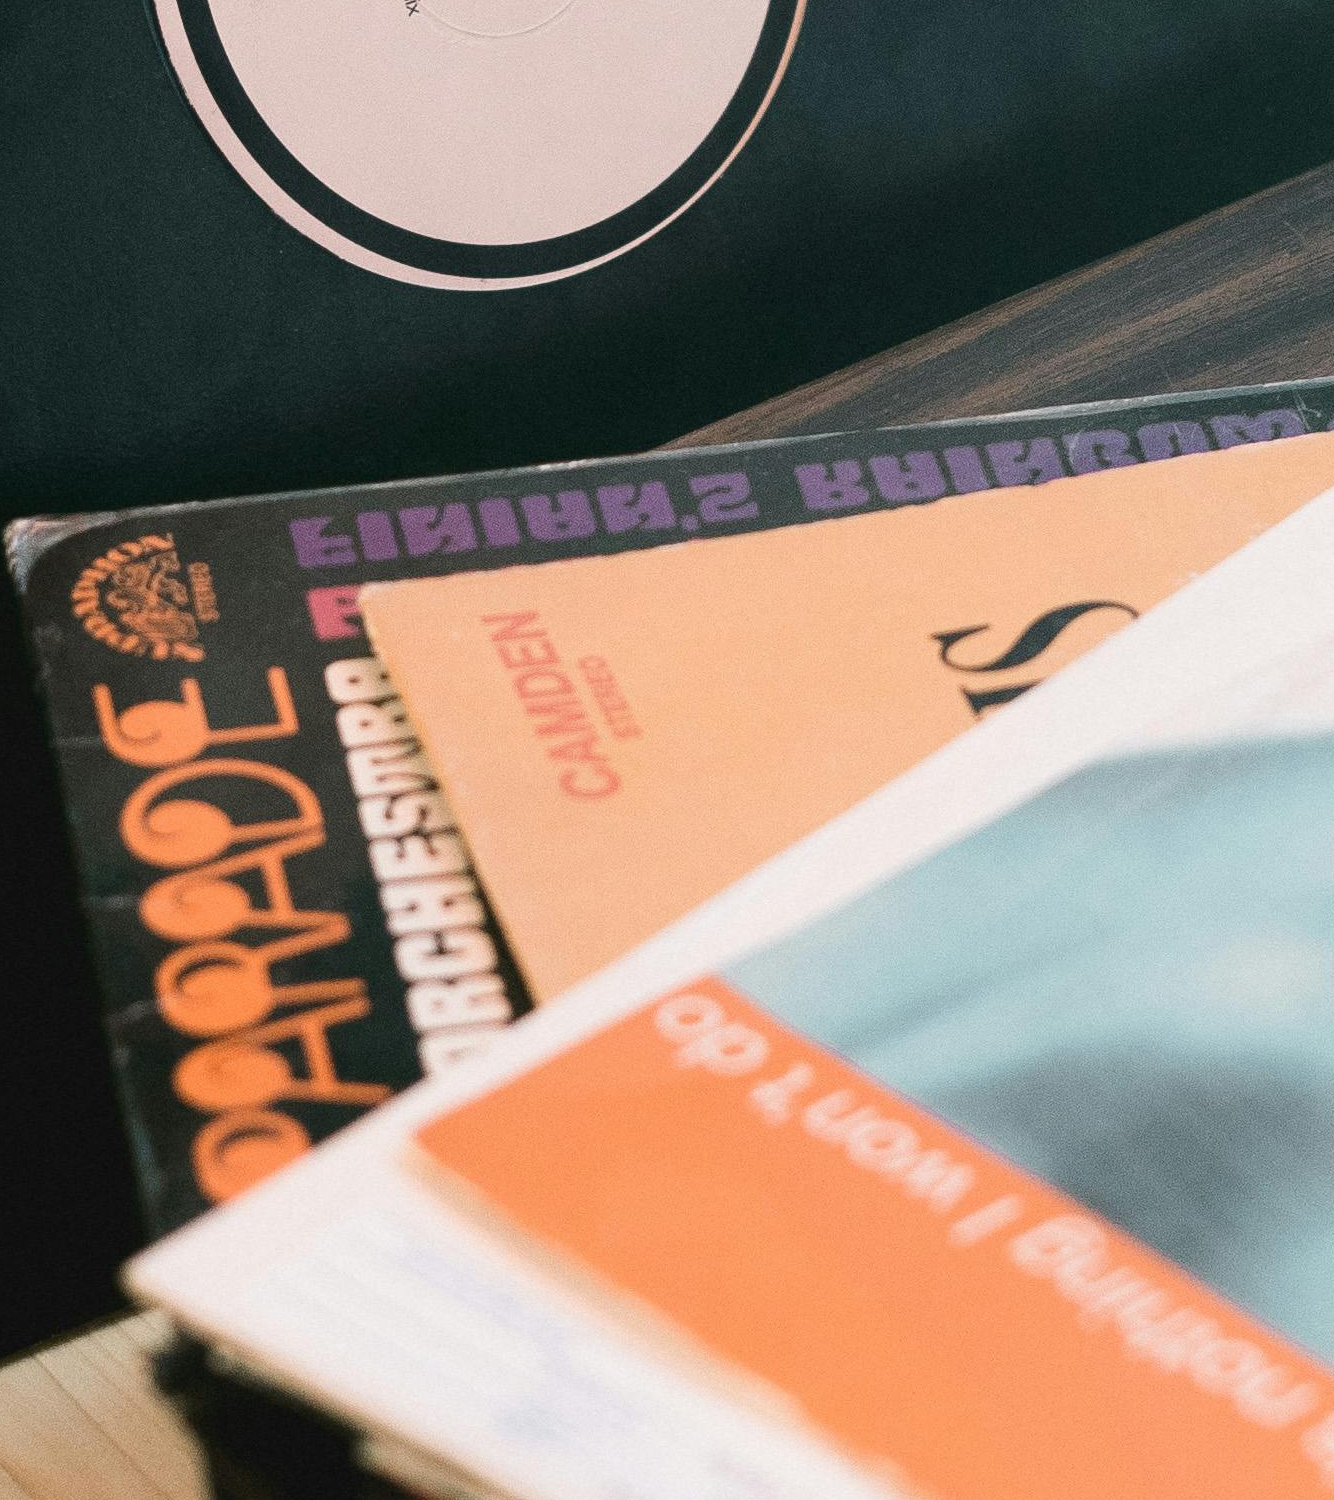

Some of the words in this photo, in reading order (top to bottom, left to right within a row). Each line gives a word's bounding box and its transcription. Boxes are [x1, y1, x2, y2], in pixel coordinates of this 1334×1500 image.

[481, 610, 622, 802] CAMDEN
[654, 992, 770, 1078] do
[747, 1060, 977, 1216] won't
[946, 1192, 1025, 1249] I
[1007, 1211, 1323, 1432] nothing
